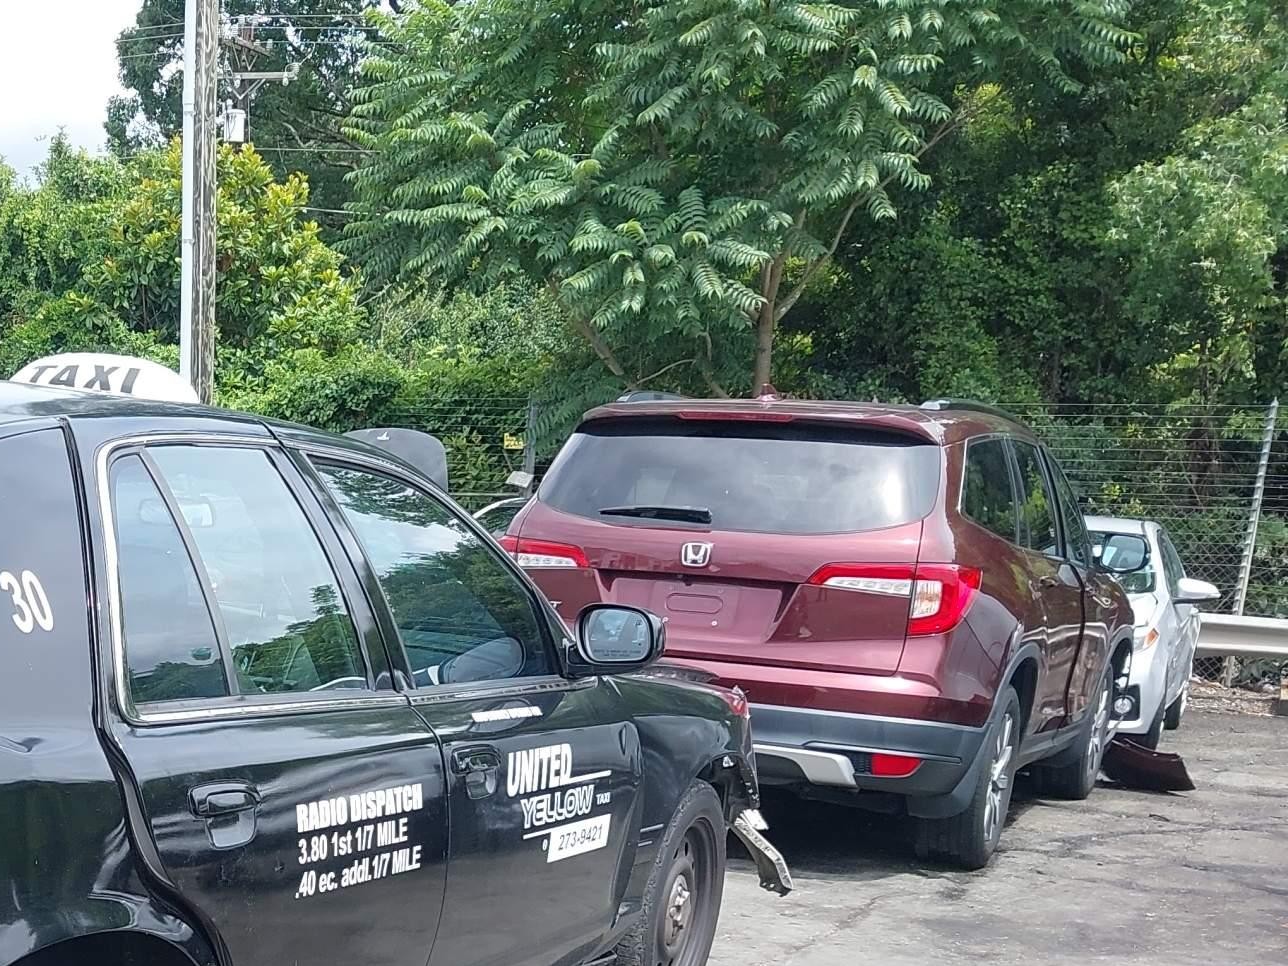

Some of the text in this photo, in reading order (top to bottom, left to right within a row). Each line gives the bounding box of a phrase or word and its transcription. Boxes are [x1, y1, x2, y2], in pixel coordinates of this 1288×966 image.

[29, 364, 141, 394] TAXI
[0, 569, 54, 634] 30
[507, 743, 573, 797] UNITED
[296, 783, 423, 833] RADIO DISPATCH
[520, 784, 611, 830] YELLOW TAXI
[298, 817, 408, 865] 3.80 1st 1/7 MILE
[558, 824, 603, 852] 273-9421
[295, 870, 316, 899] .40
[318, 871, 338, 893] ec.
[372, 852, 391, 879] 1/7
[391, 845, 422, 875] MILE
